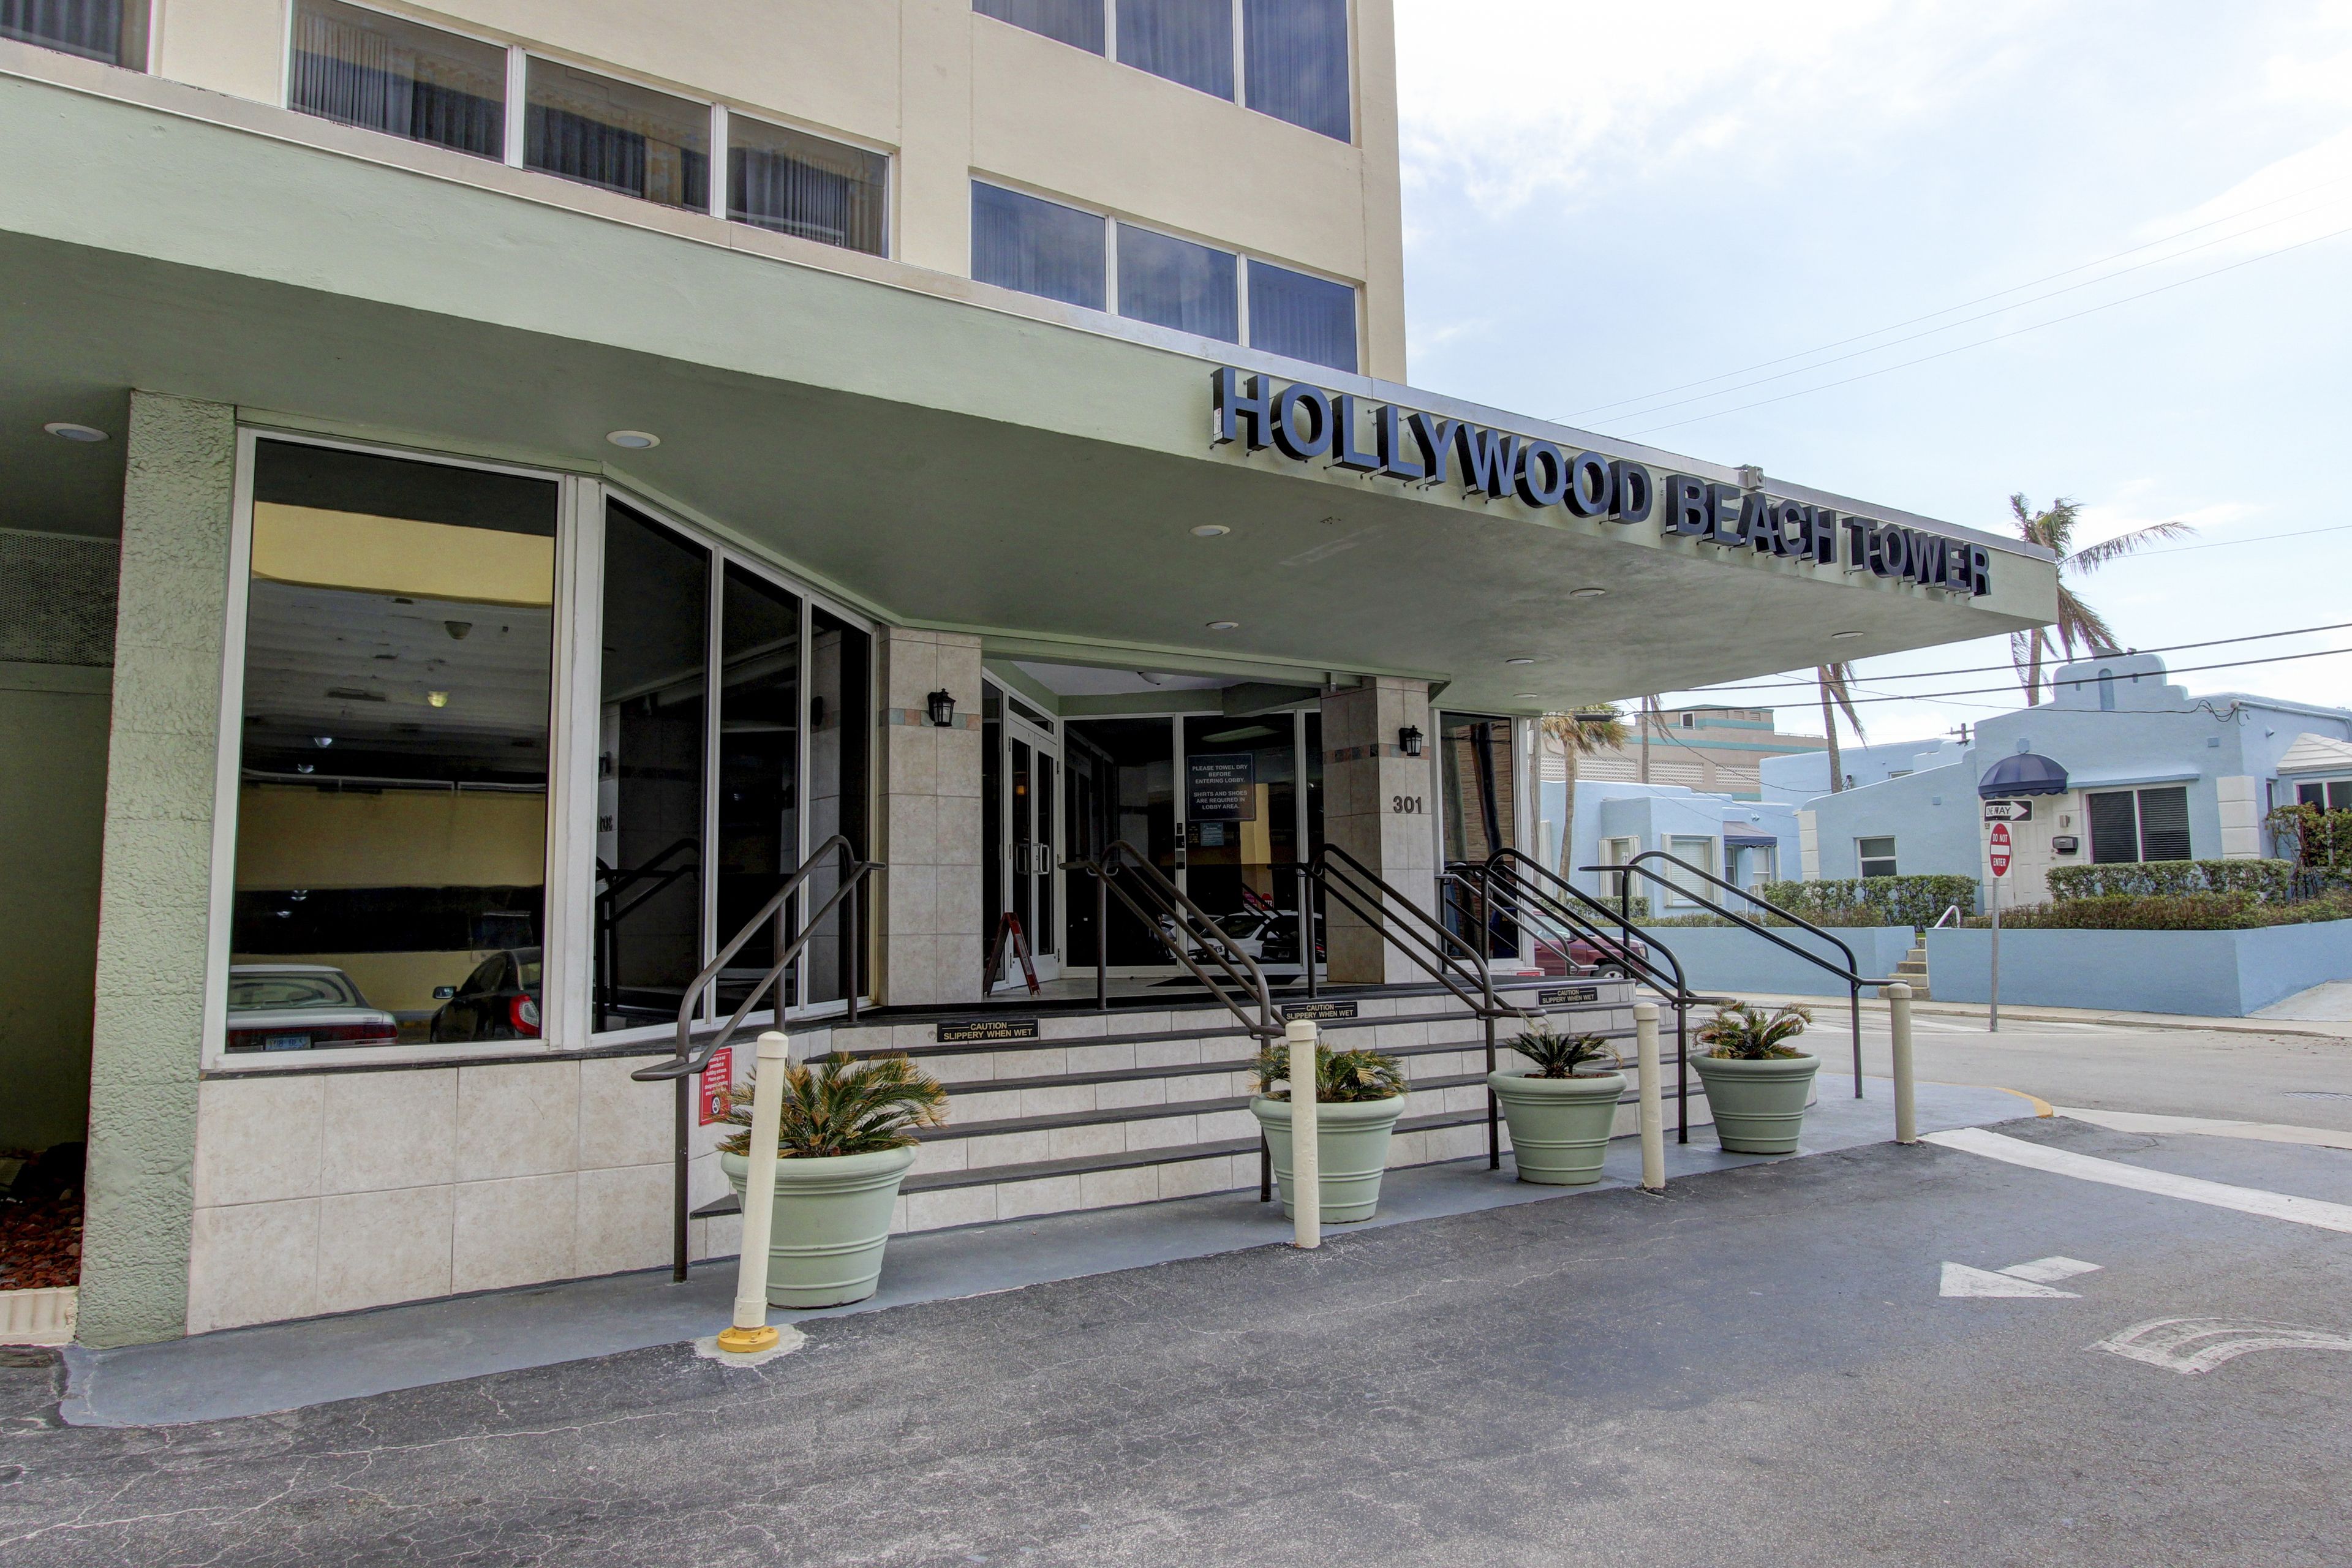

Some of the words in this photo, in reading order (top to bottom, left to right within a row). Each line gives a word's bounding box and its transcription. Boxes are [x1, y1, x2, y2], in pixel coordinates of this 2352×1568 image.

[1213, 367, 1653, 524] HOLLYWOOD
[1666, 474, 1836, 565] BEACH
[1842, 516, 1991, 597] TOWER
[1393, 796, 1422, 814] 301
[1994, 806, 2011, 815] WAY
[1992, 833, 1997, 842] DO
[1999, 834, 2008, 843] NOT
[1993, 858, 2006, 867] ENTER
[944, 1031, 984, 1040] SLIPPERY
